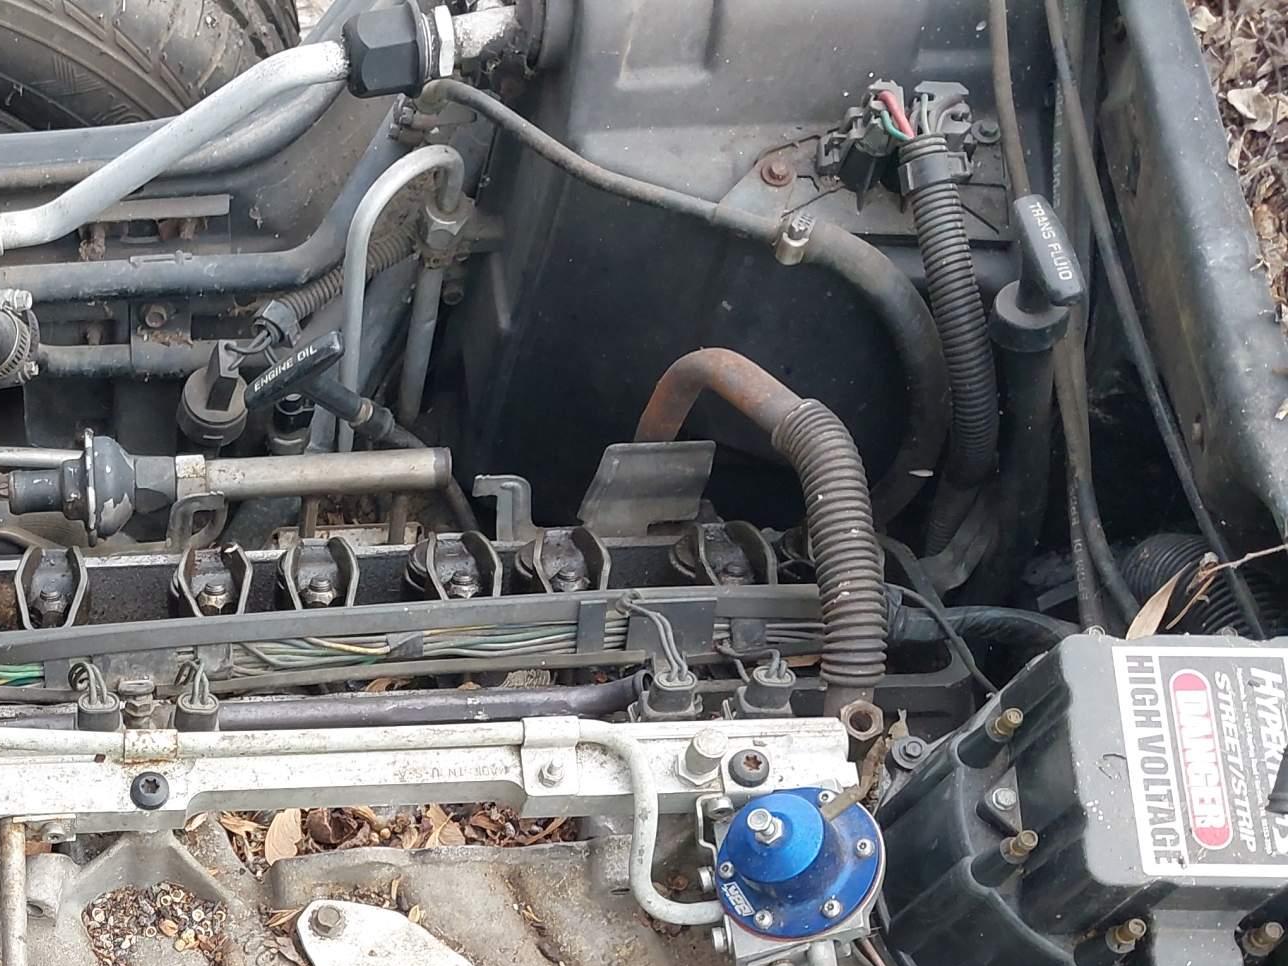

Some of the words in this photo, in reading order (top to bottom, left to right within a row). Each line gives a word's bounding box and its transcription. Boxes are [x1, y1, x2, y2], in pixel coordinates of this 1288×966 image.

[1029, 201, 1056, 240] TRANS
[1047, 242, 1073, 281] FLUID
[253, 357, 294, 392] ENGINE
[297, 344, 318, 362] OIL
[1126, 656, 1162, 728] HIGH
[1137, 734, 1184, 864] VOLTAGE
[1175, 690, 1226, 830] DANGER
[1215, 671, 1257, 852] STREET/STRIP
